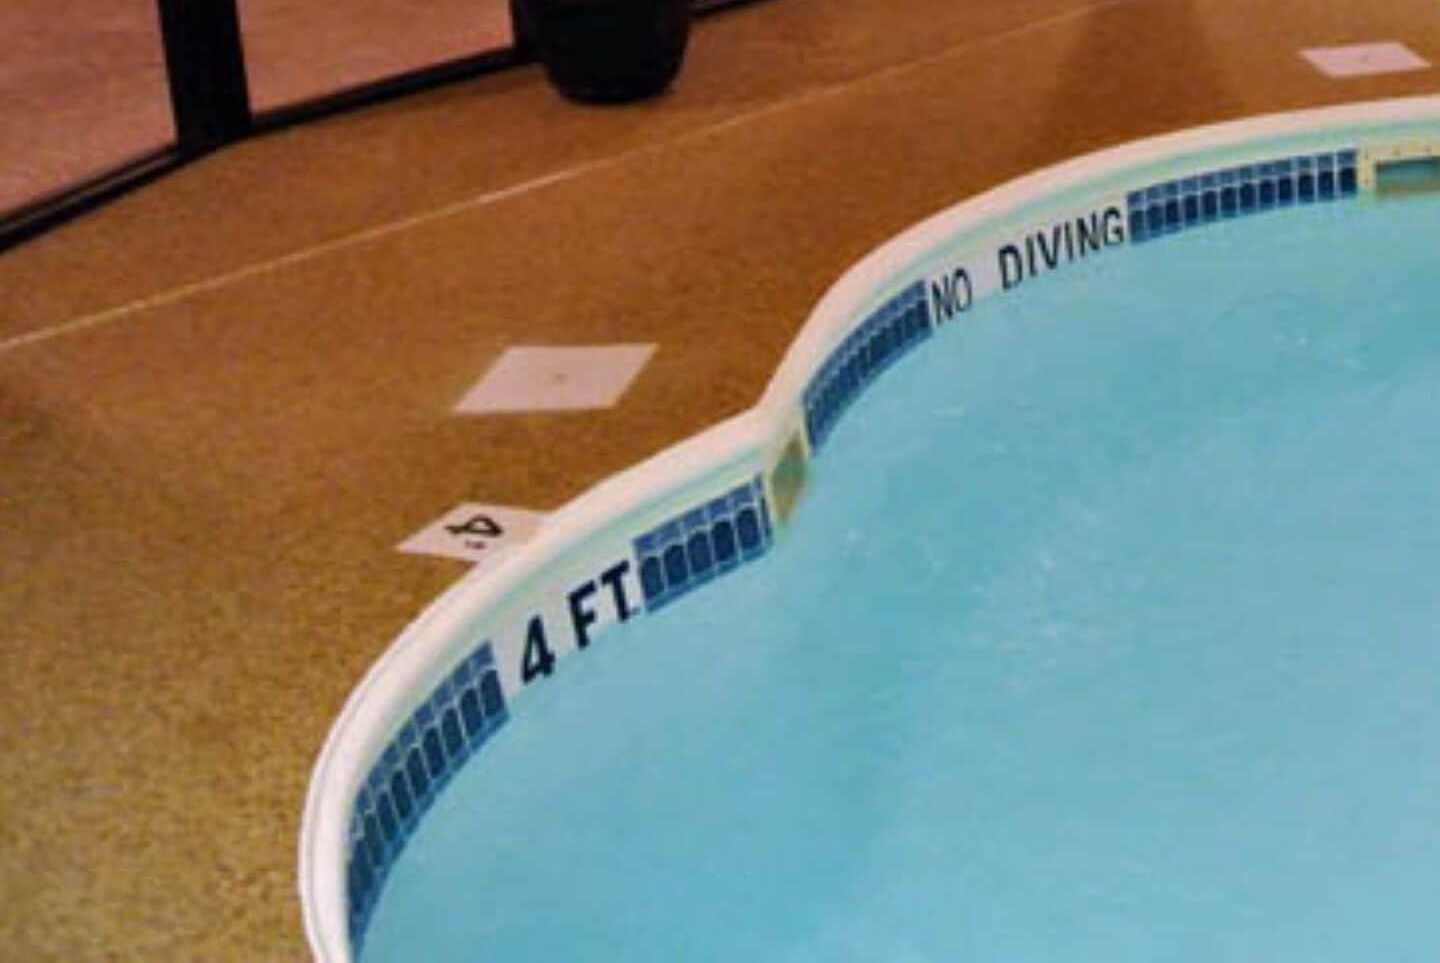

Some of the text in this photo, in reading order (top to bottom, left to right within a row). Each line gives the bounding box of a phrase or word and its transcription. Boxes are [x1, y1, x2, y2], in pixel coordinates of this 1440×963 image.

[930, 205, 1125, 325] NO DIVING
[520, 560, 632, 686] 4 FT
